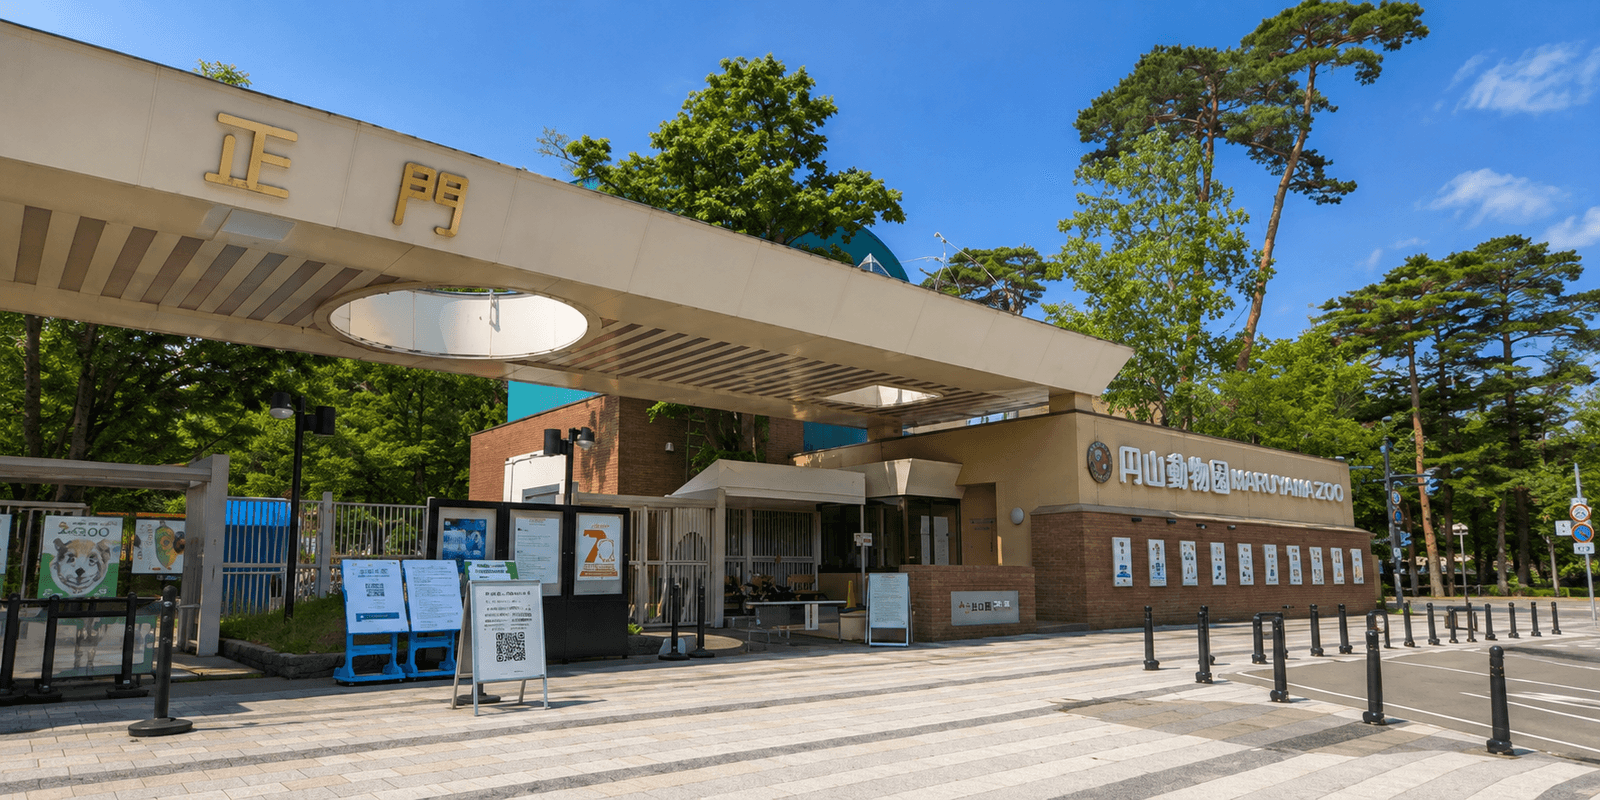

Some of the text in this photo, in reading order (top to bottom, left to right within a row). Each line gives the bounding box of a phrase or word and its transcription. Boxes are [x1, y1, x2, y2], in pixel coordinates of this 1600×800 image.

[204, 112, 470, 237] 正門
[1118, 445, 1230, 495] 円山動物園
[1230, 468, 1314, 498] MARUYAMA
[1313, 481, 1344, 502] ZOO
